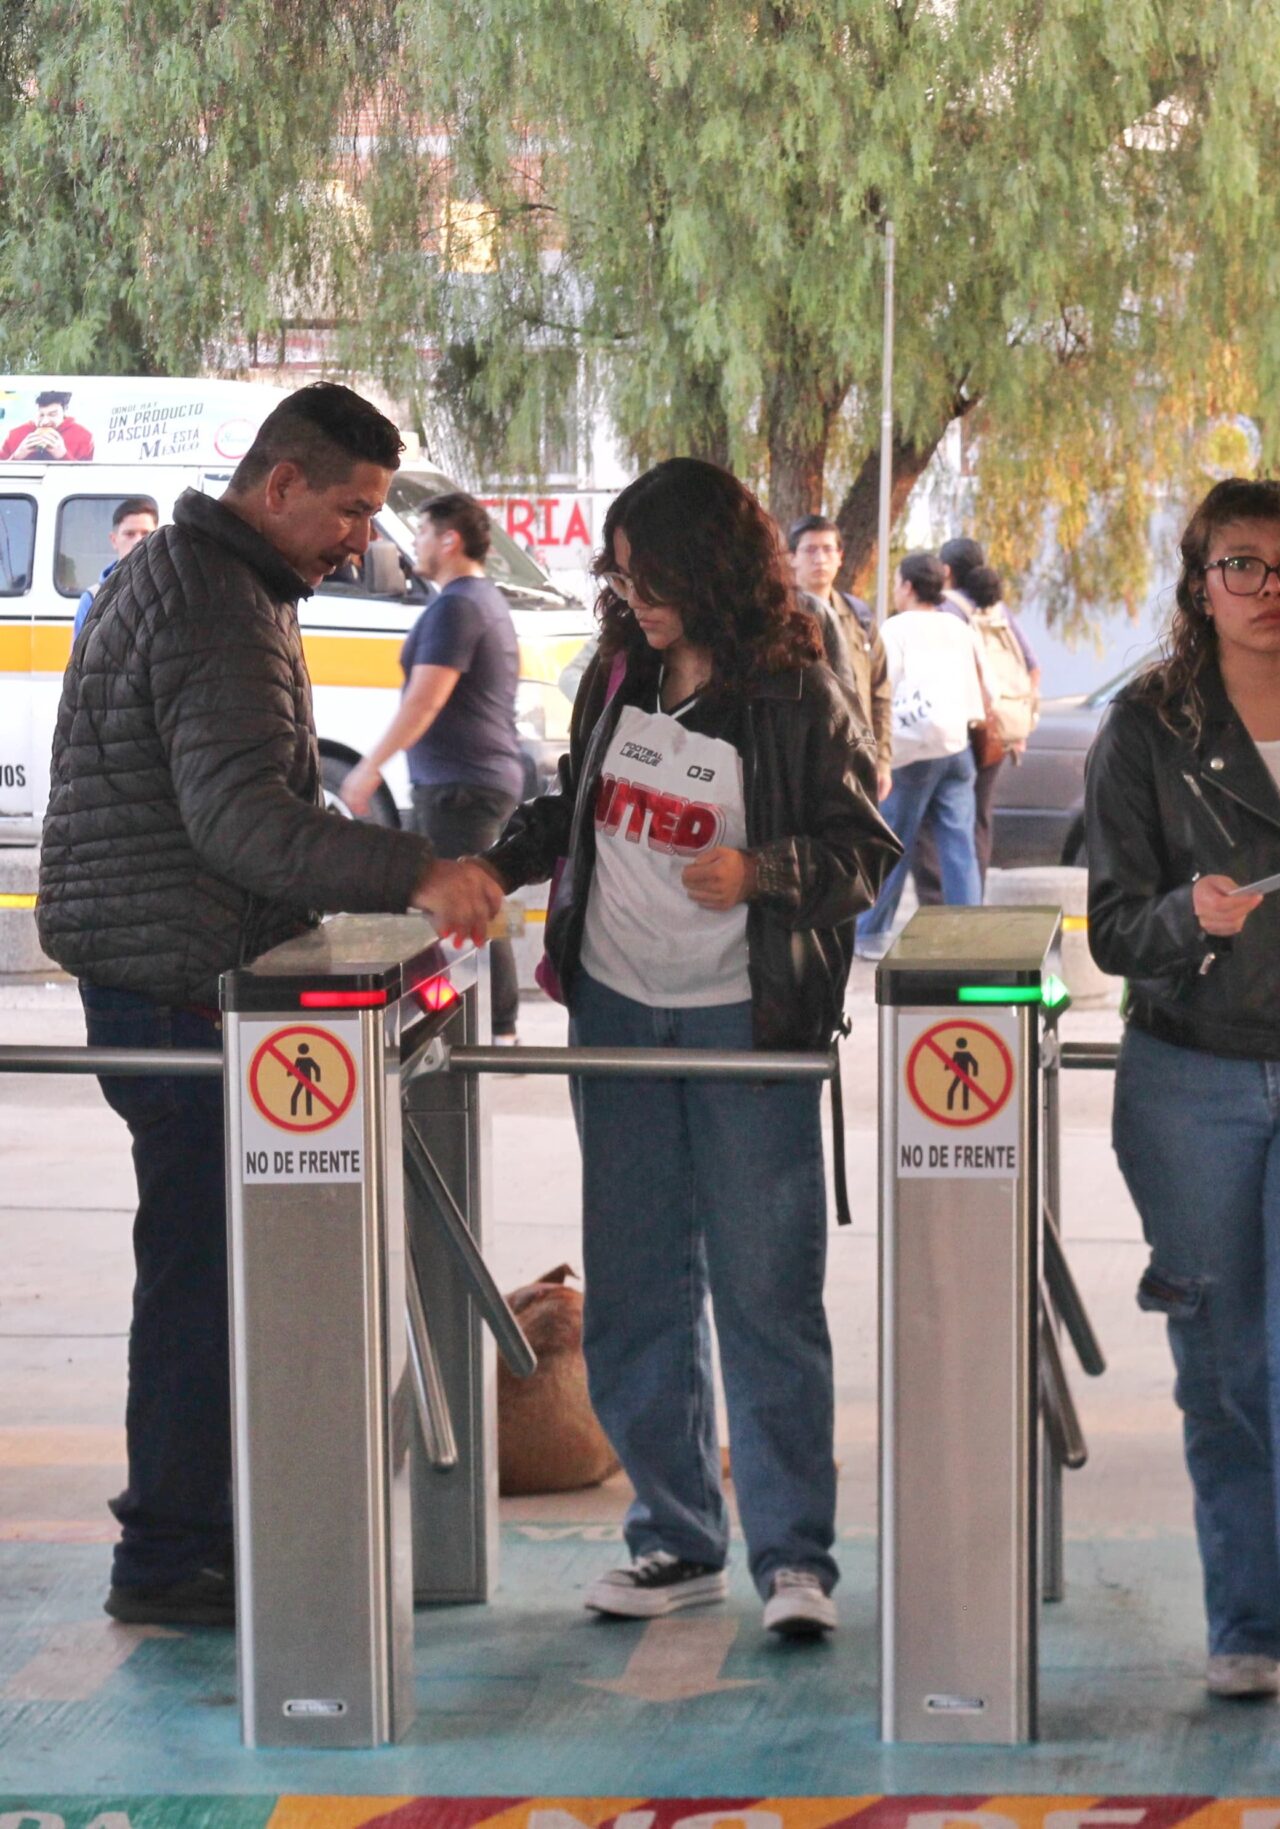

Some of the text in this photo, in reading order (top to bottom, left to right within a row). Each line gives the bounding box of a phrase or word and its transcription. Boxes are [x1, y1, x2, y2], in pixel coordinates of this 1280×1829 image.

[109, 402, 204, 429] UN PRODUCTO
[108, 421, 168, 443] PASCUAL
[620, 746, 662, 767] LEAGUE
[687, 765, 715, 782] 03
[246, 1150, 360, 1174] NO DE FRENTE
[901, 1145, 1016, 1169] NO DE FRENTE
